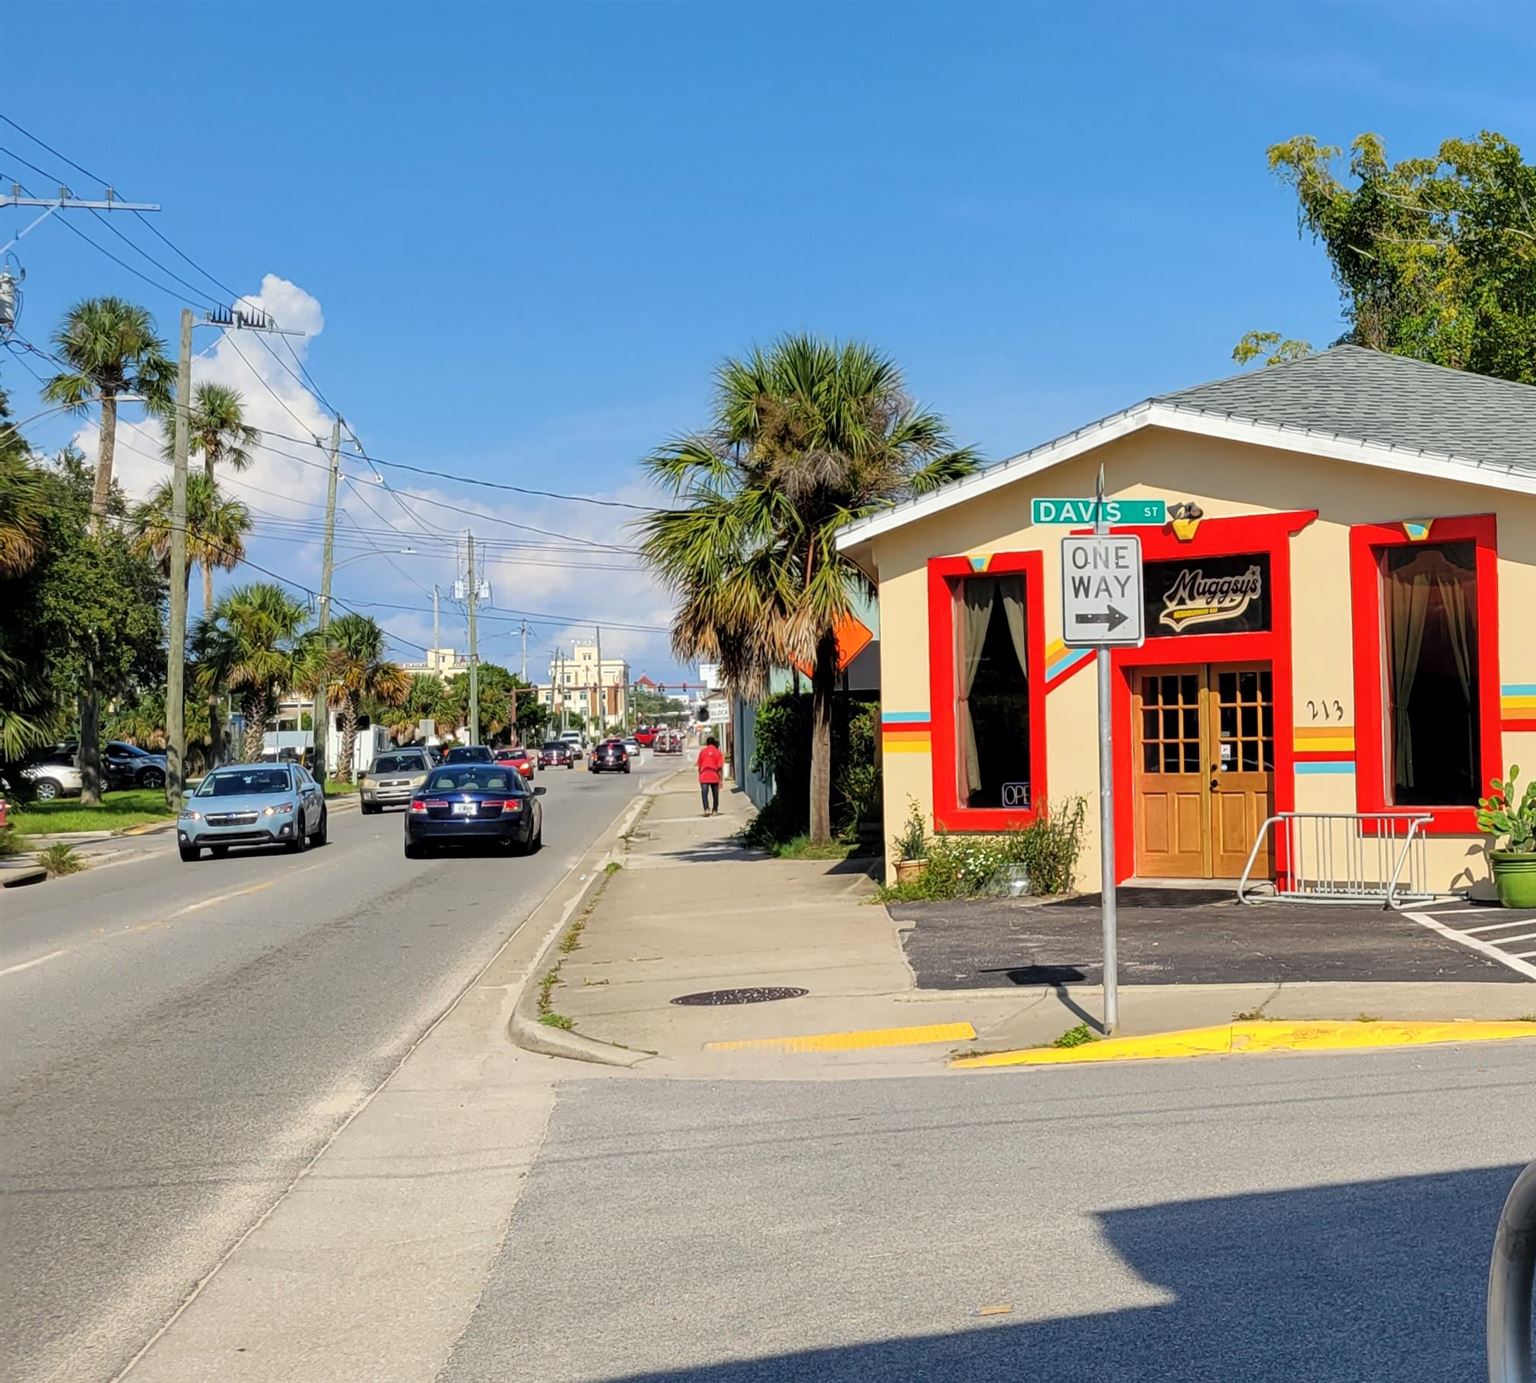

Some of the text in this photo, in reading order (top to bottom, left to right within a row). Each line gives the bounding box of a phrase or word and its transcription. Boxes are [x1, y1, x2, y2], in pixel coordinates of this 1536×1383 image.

[1039, 502, 1158, 522] DAVIS ST
[1072, 546, 1130, 570] ONE
[1071, 575, 1132, 599] WAY
[1306, 700, 1344, 721] 213
